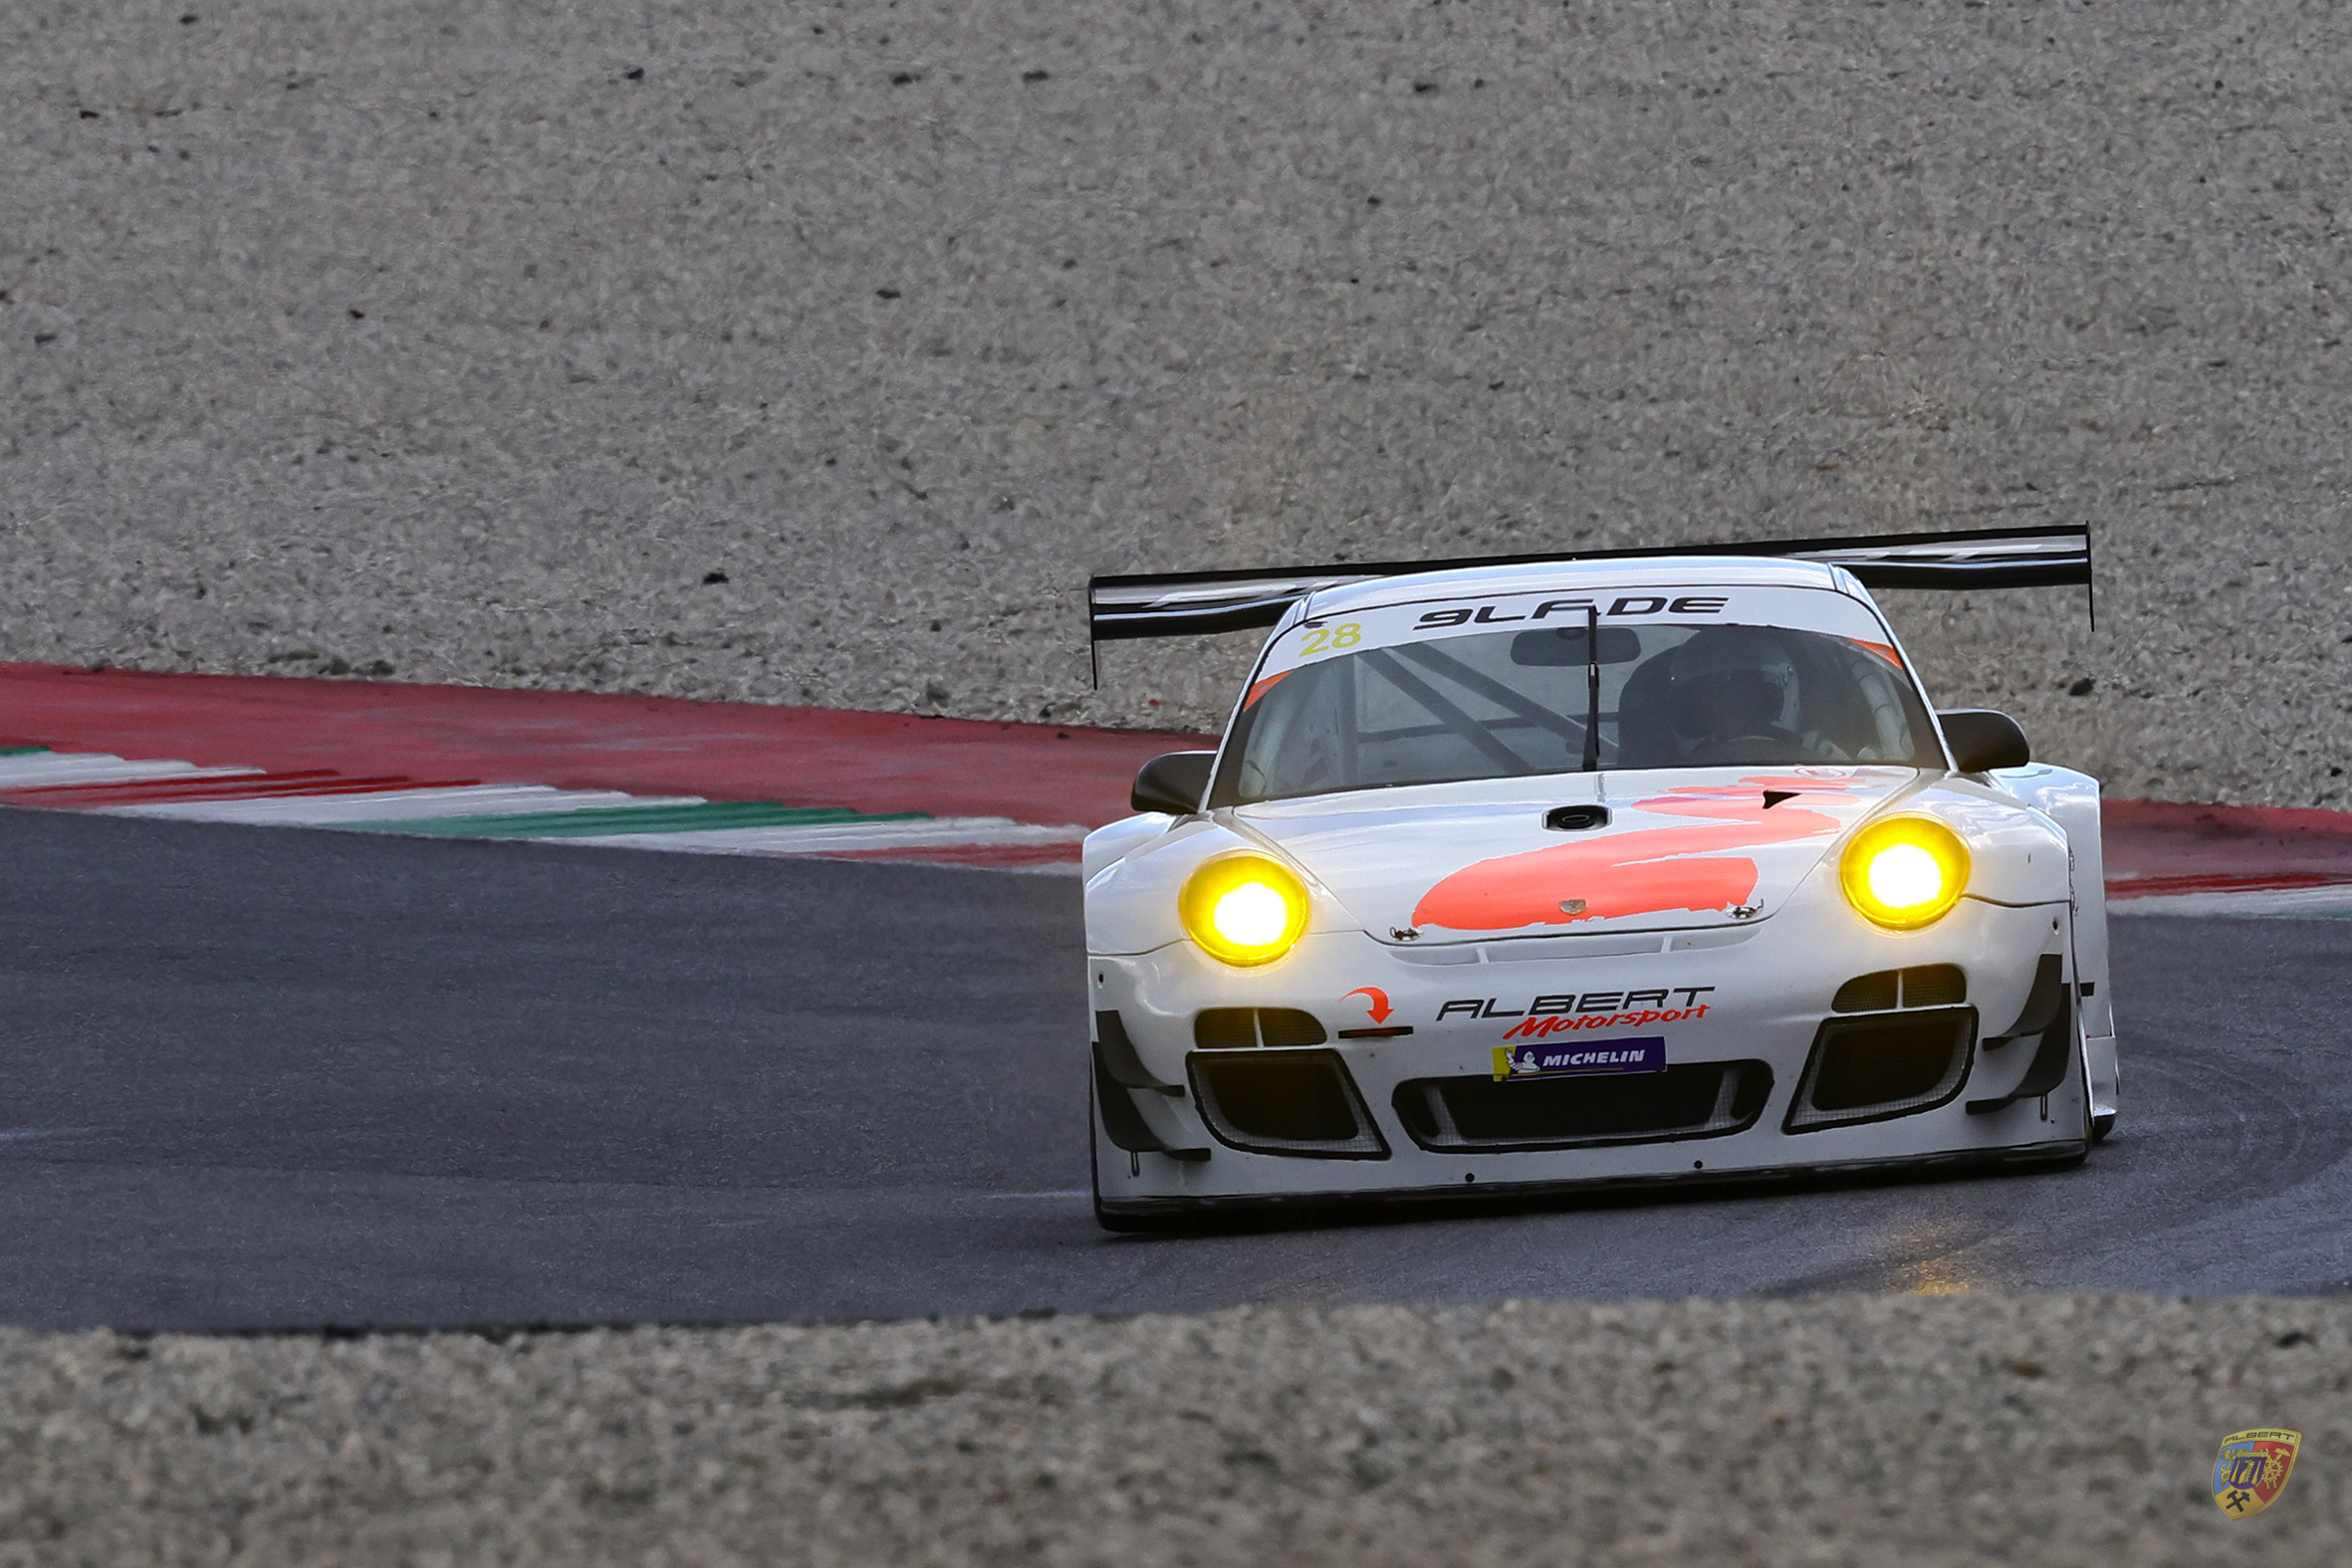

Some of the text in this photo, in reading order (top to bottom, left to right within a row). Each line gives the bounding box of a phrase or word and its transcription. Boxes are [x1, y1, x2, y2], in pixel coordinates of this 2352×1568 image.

[1298, 622, 1361, 657] 28
[1436, 986, 1716, 1021] ALBERT
[1502, 1004, 1712, 1039] Motorsport
[1542, 1049, 1645, 1066] MICHELIN
